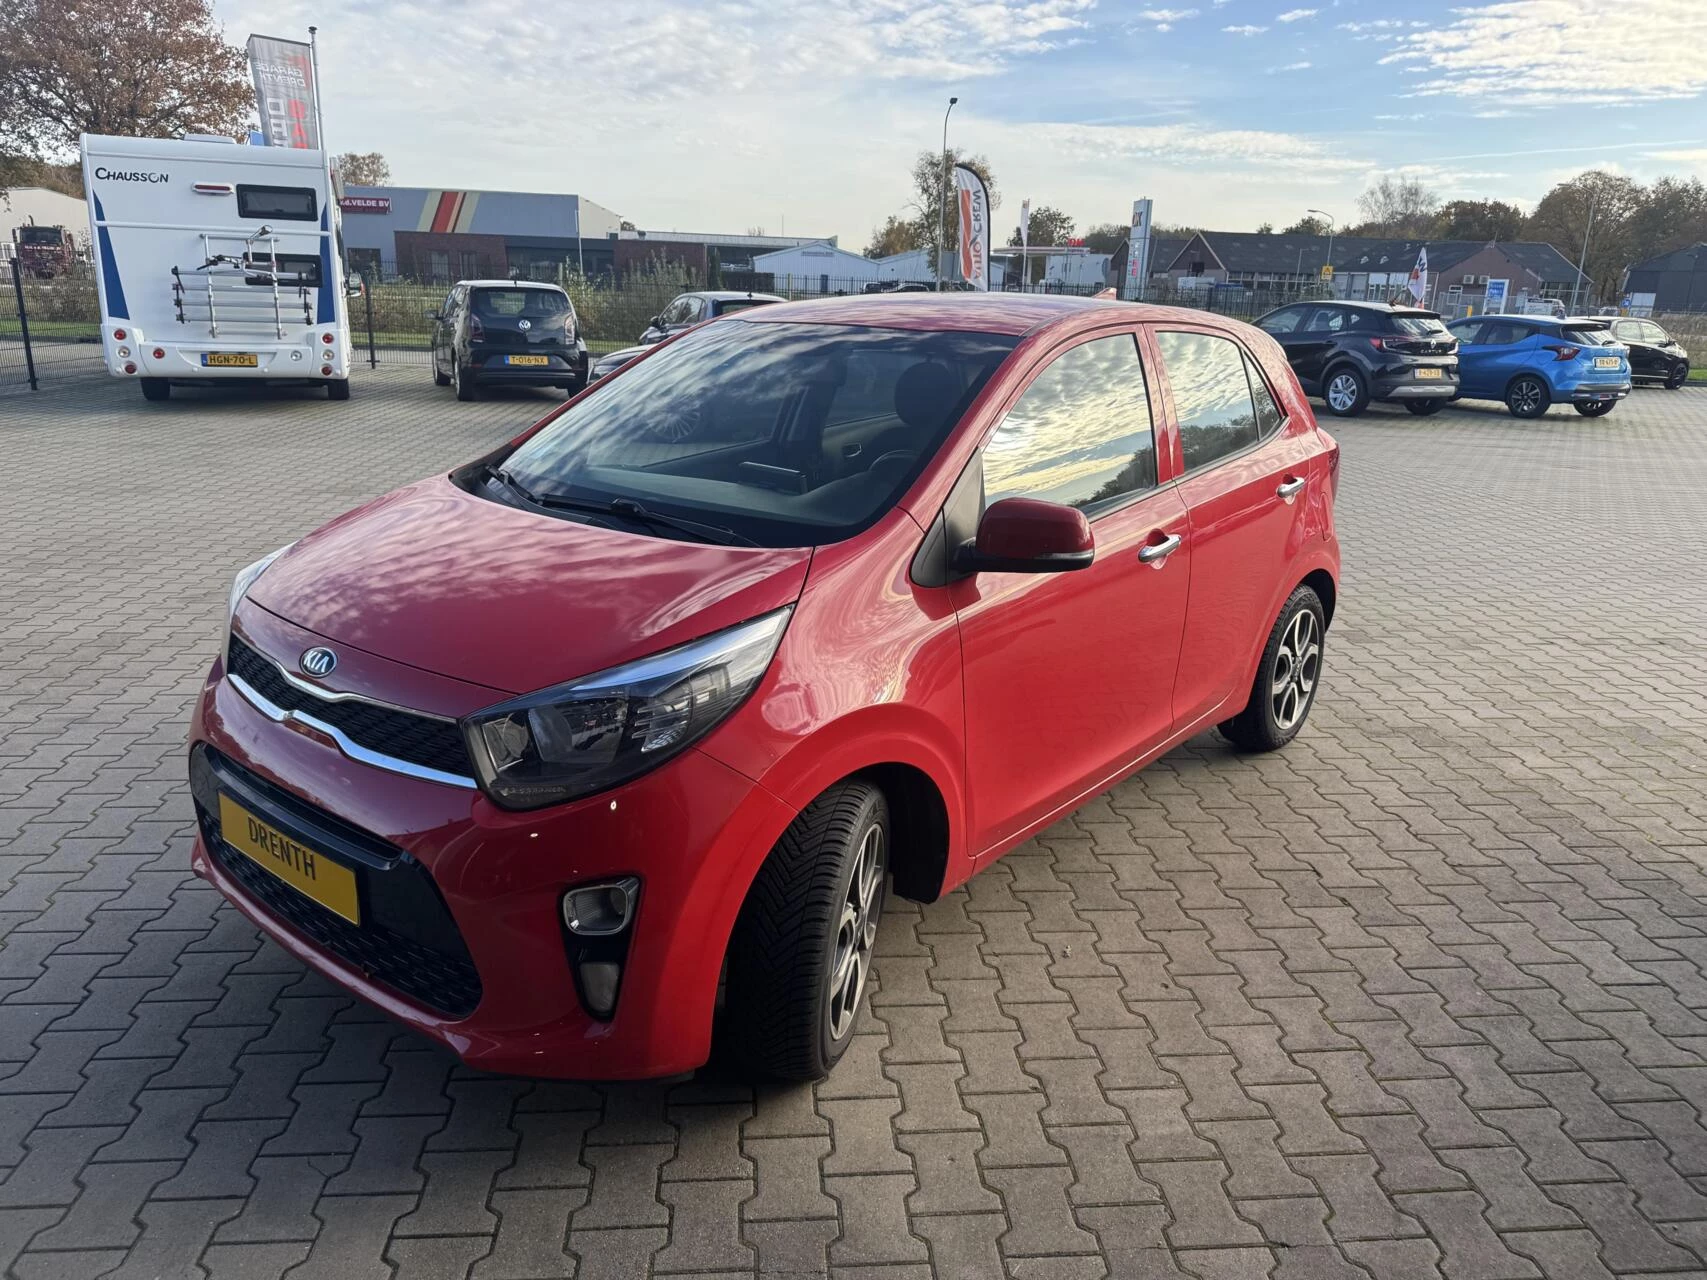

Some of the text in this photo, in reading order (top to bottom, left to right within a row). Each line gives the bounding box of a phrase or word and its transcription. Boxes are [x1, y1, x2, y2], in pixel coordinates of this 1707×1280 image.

[95, 167, 169, 183] CHAUSSON
[208, 355, 256, 365] HGN-70-L
[303, 650, 330, 673] KIA
[247, 815, 316, 881] DRENTH
